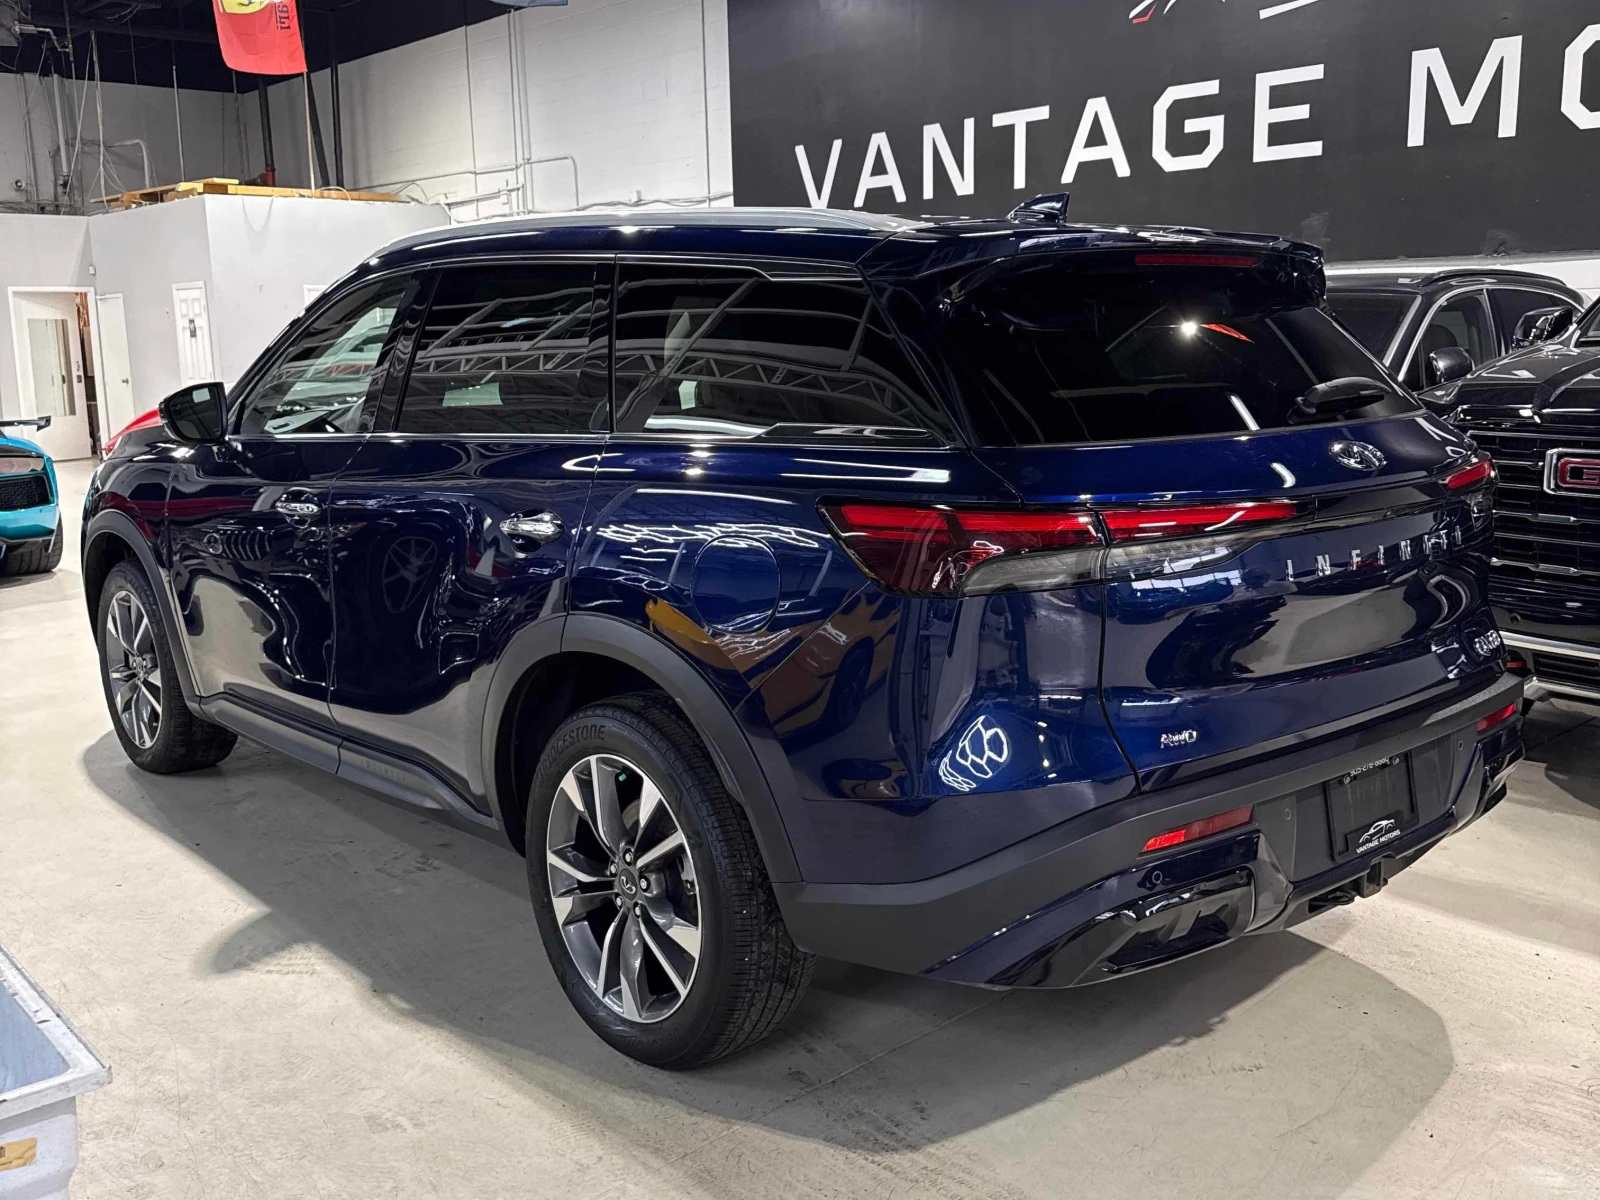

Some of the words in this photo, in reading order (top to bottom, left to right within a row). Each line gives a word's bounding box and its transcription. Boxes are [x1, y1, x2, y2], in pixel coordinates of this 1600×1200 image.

[794, 63, 1324, 208] VANTAGE
[1355, 839, 1380, 854] VANTAGE
[1379, 828, 1401, 843] MOTORS
